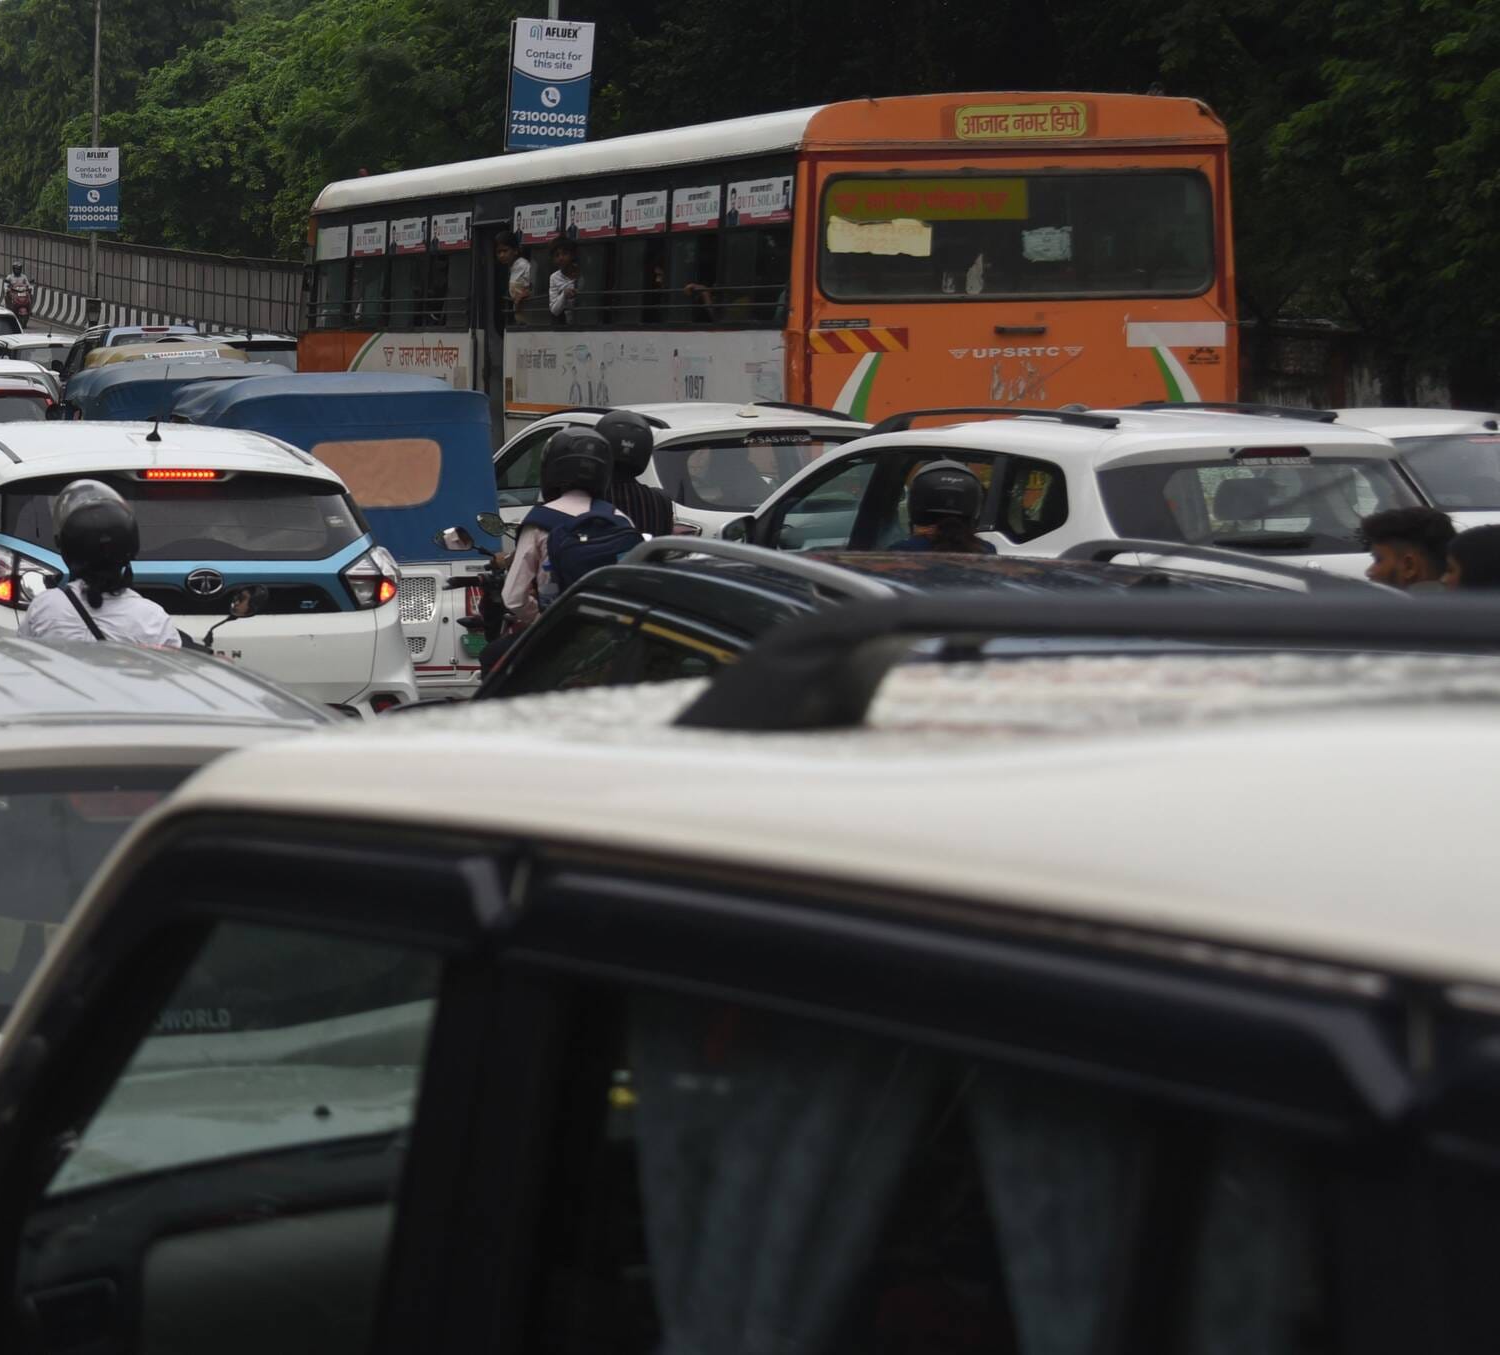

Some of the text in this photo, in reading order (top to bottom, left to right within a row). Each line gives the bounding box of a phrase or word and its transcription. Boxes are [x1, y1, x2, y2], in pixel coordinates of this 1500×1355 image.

[545, 27, 579, 39] AFLUEX
[526, 48, 582, 61] Contact for
[534, 60, 573, 70] this site
[512, 110, 586, 125] 7310000412
[962, 106, 1079, 135] आजाद नगर डिपो
[511, 124, 585, 138] 7310000413
[87, 151, 108, 159] AFLUEX
[69, 214, 118, 222] 7310000413
[973, 347, 1060, 358] UPSRTC
[685, 375, 704, 399] 1097
